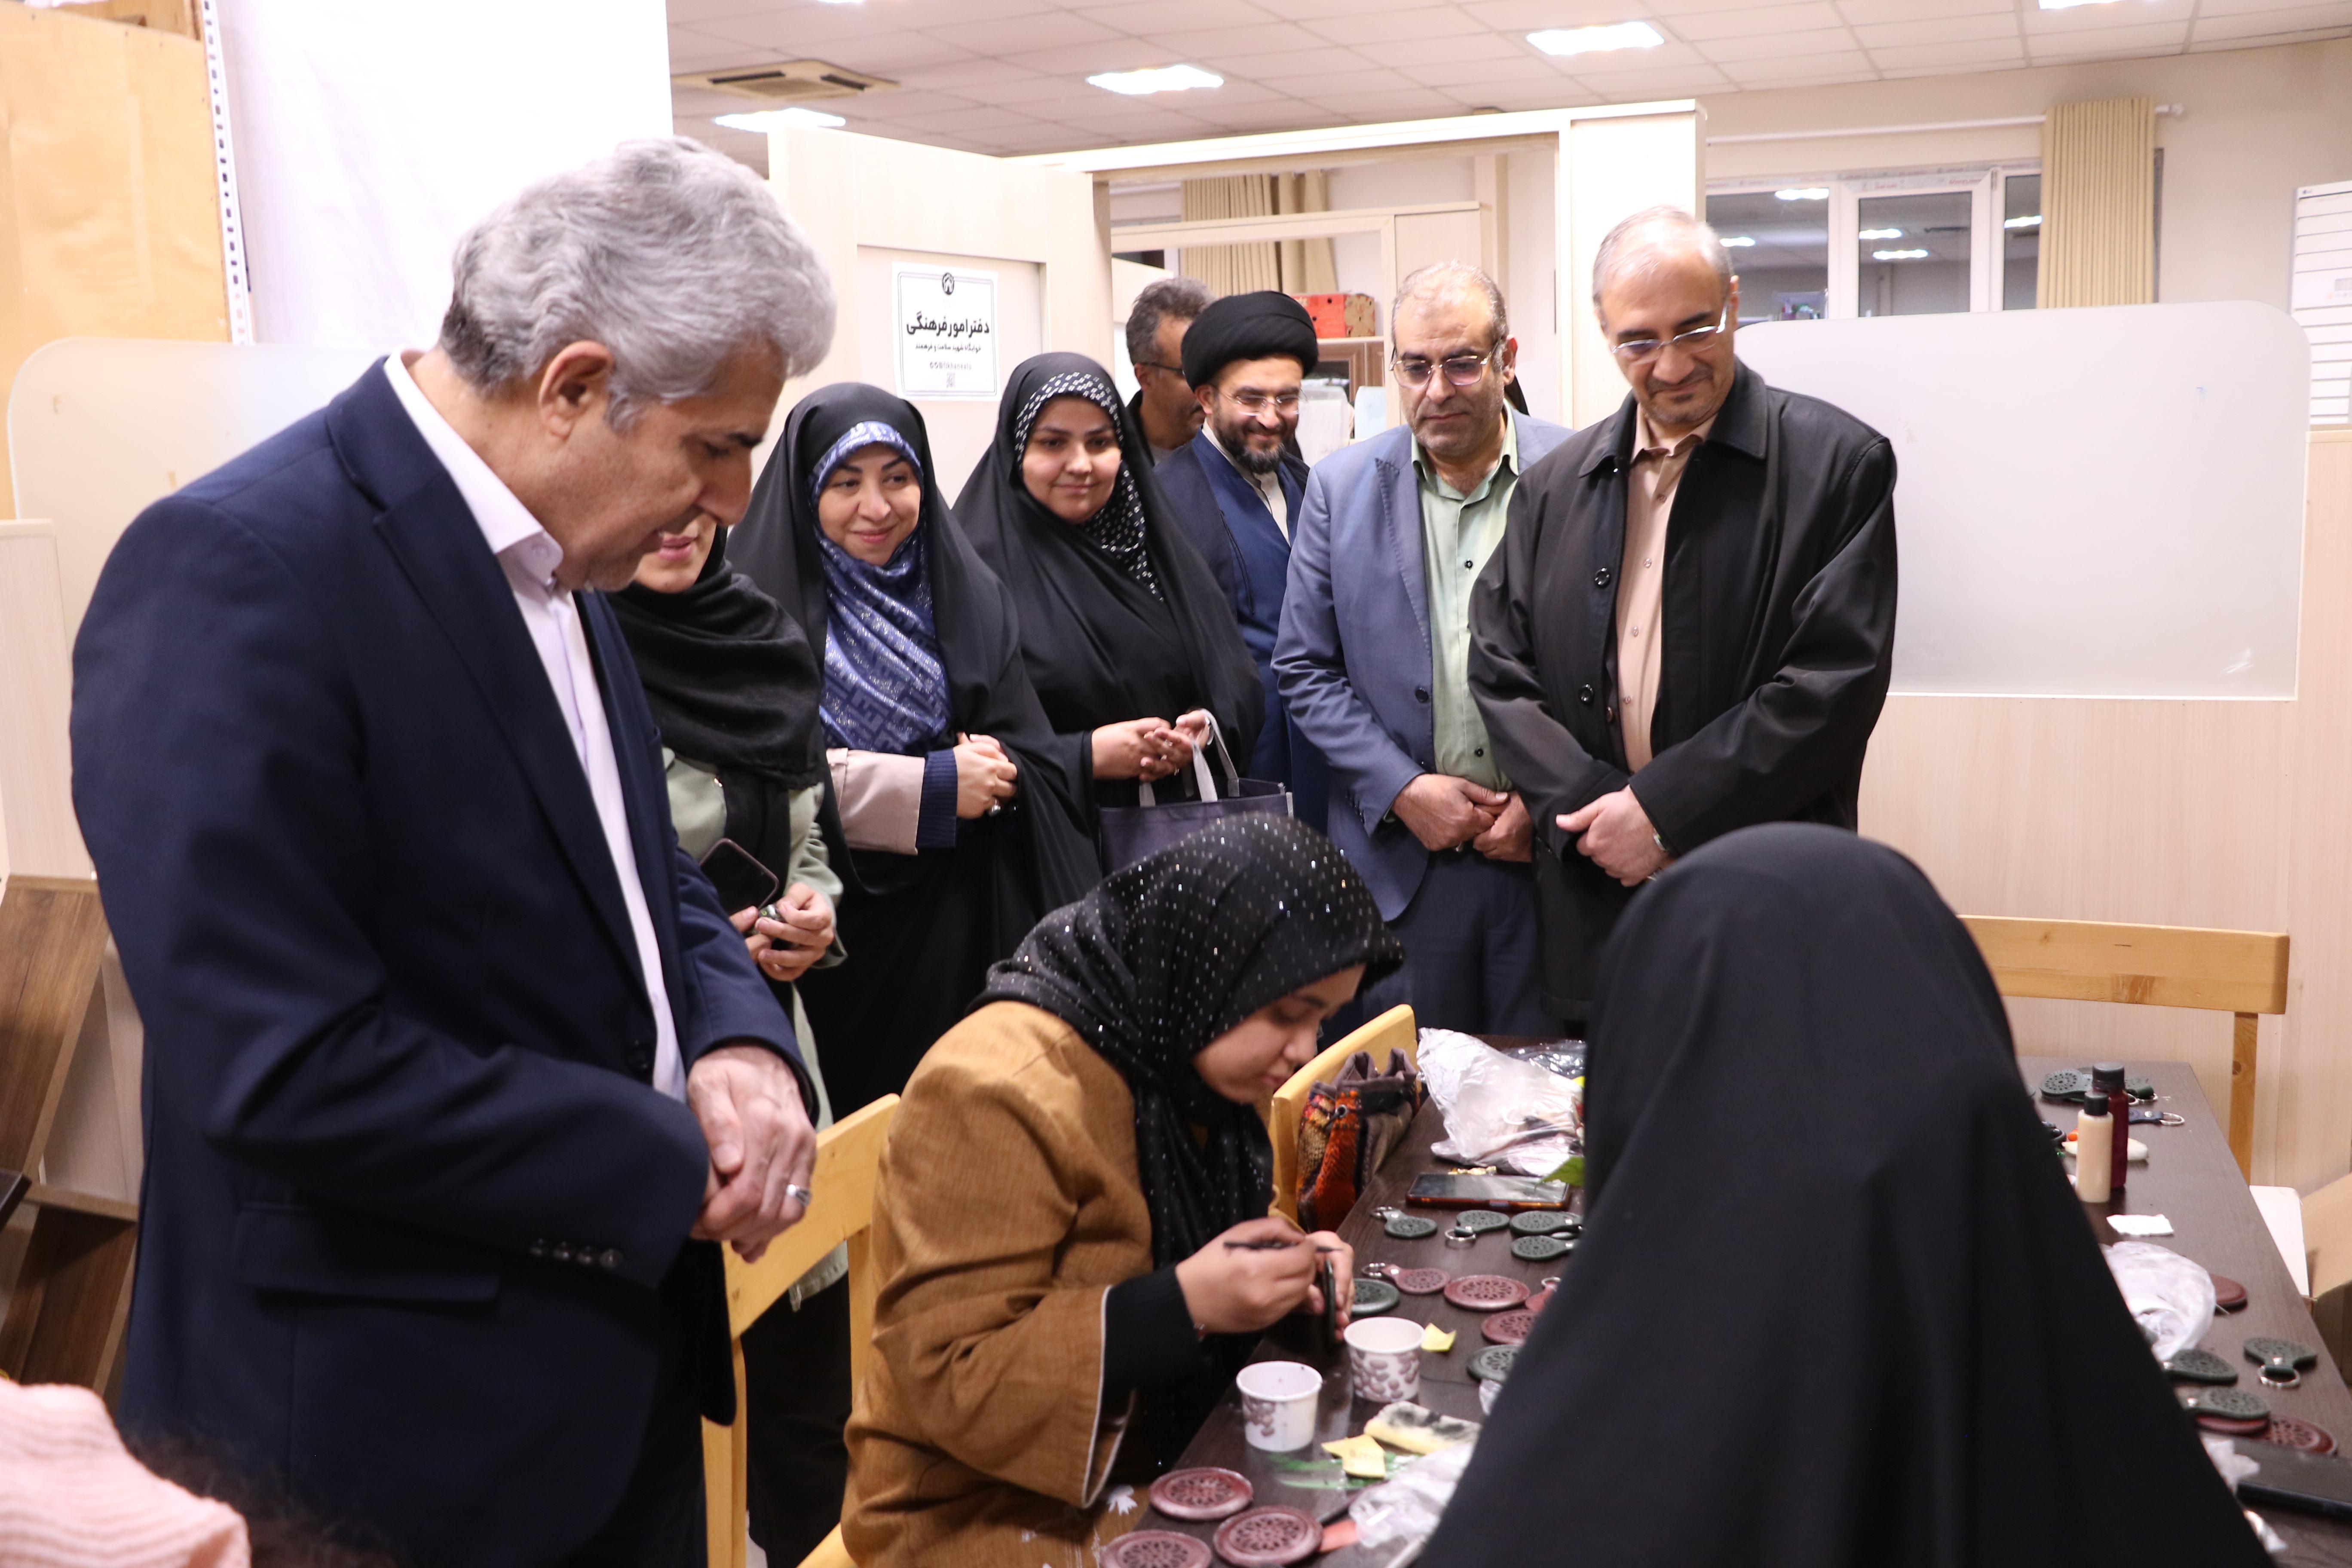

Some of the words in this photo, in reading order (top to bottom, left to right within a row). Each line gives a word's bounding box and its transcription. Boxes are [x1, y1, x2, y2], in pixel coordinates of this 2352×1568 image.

[906, 310, 947, 337] فرهنگی
[948, 318, 968, 338] امور
[968, 318, 989, 338] دفتر
